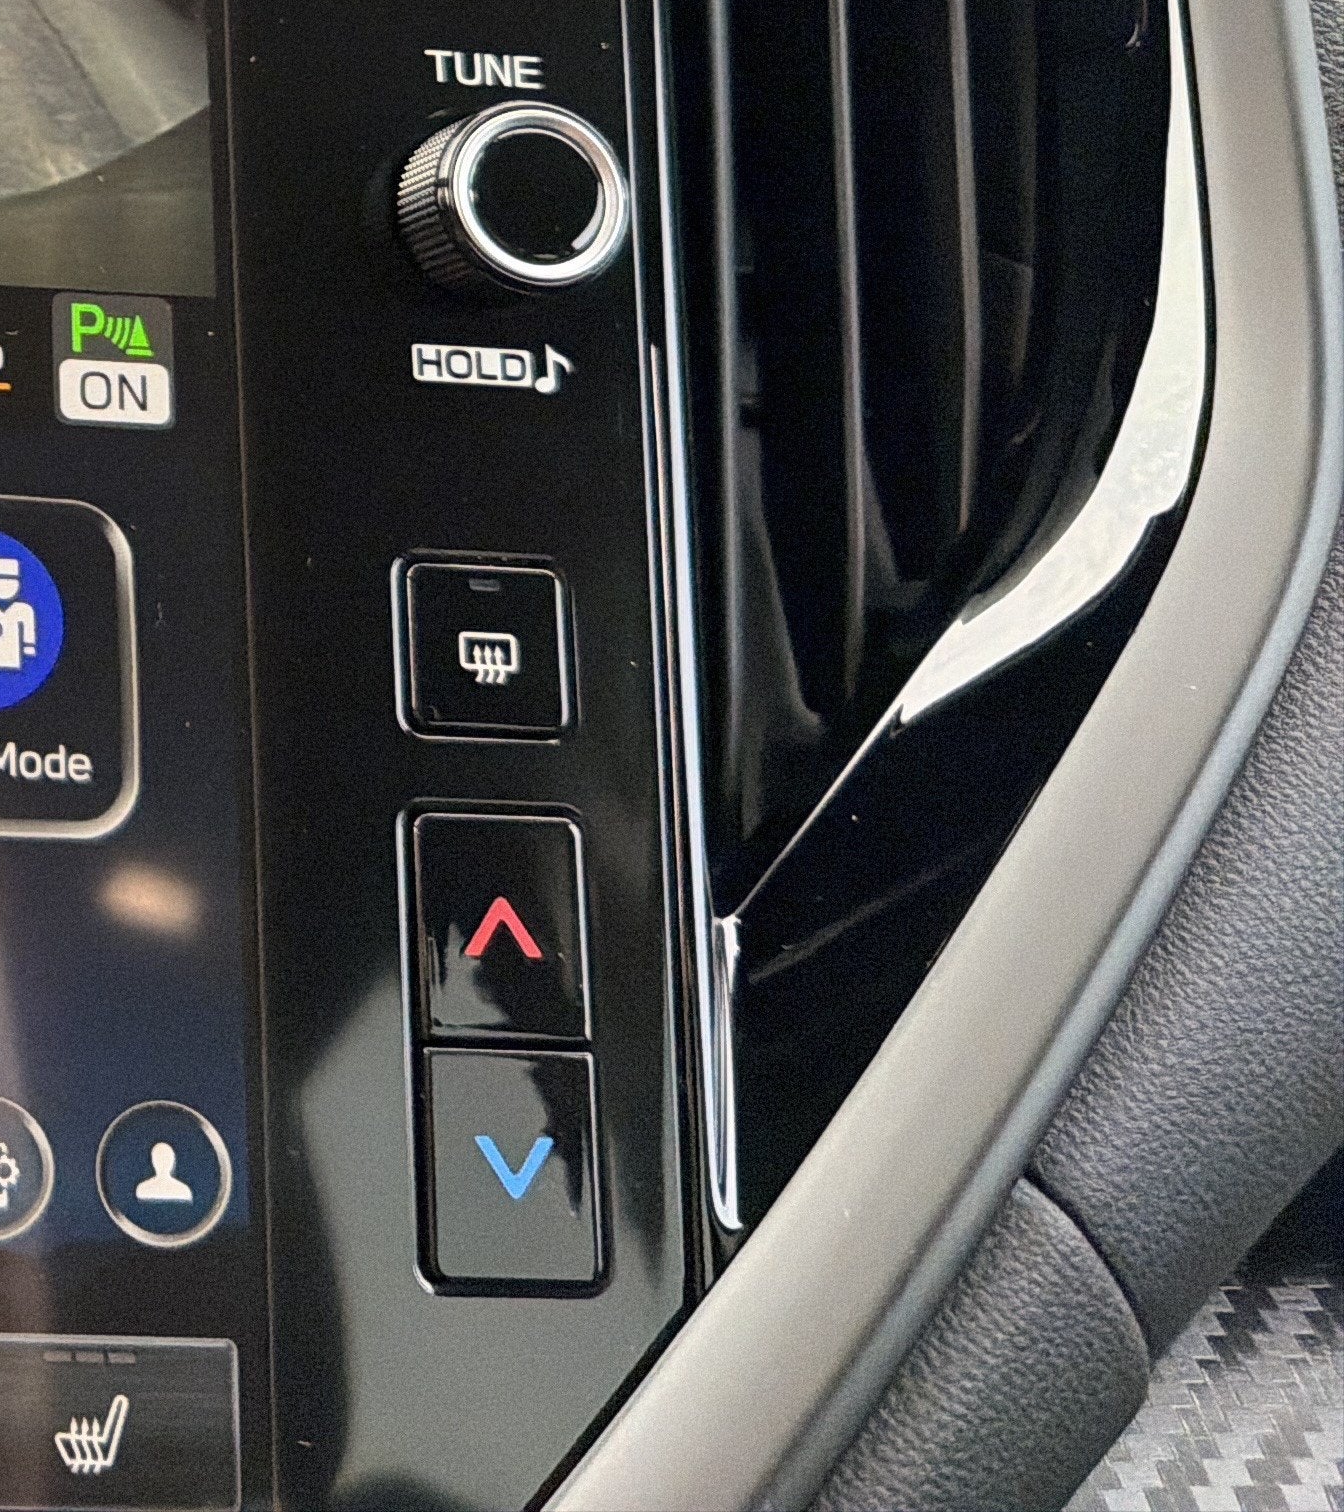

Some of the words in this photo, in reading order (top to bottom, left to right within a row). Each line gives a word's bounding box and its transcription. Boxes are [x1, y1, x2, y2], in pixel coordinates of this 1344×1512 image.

[424, 49, 545, 89] TUNE
[416, 347, 528, 382] HOLD
[79, 371, 147, 411] ON
